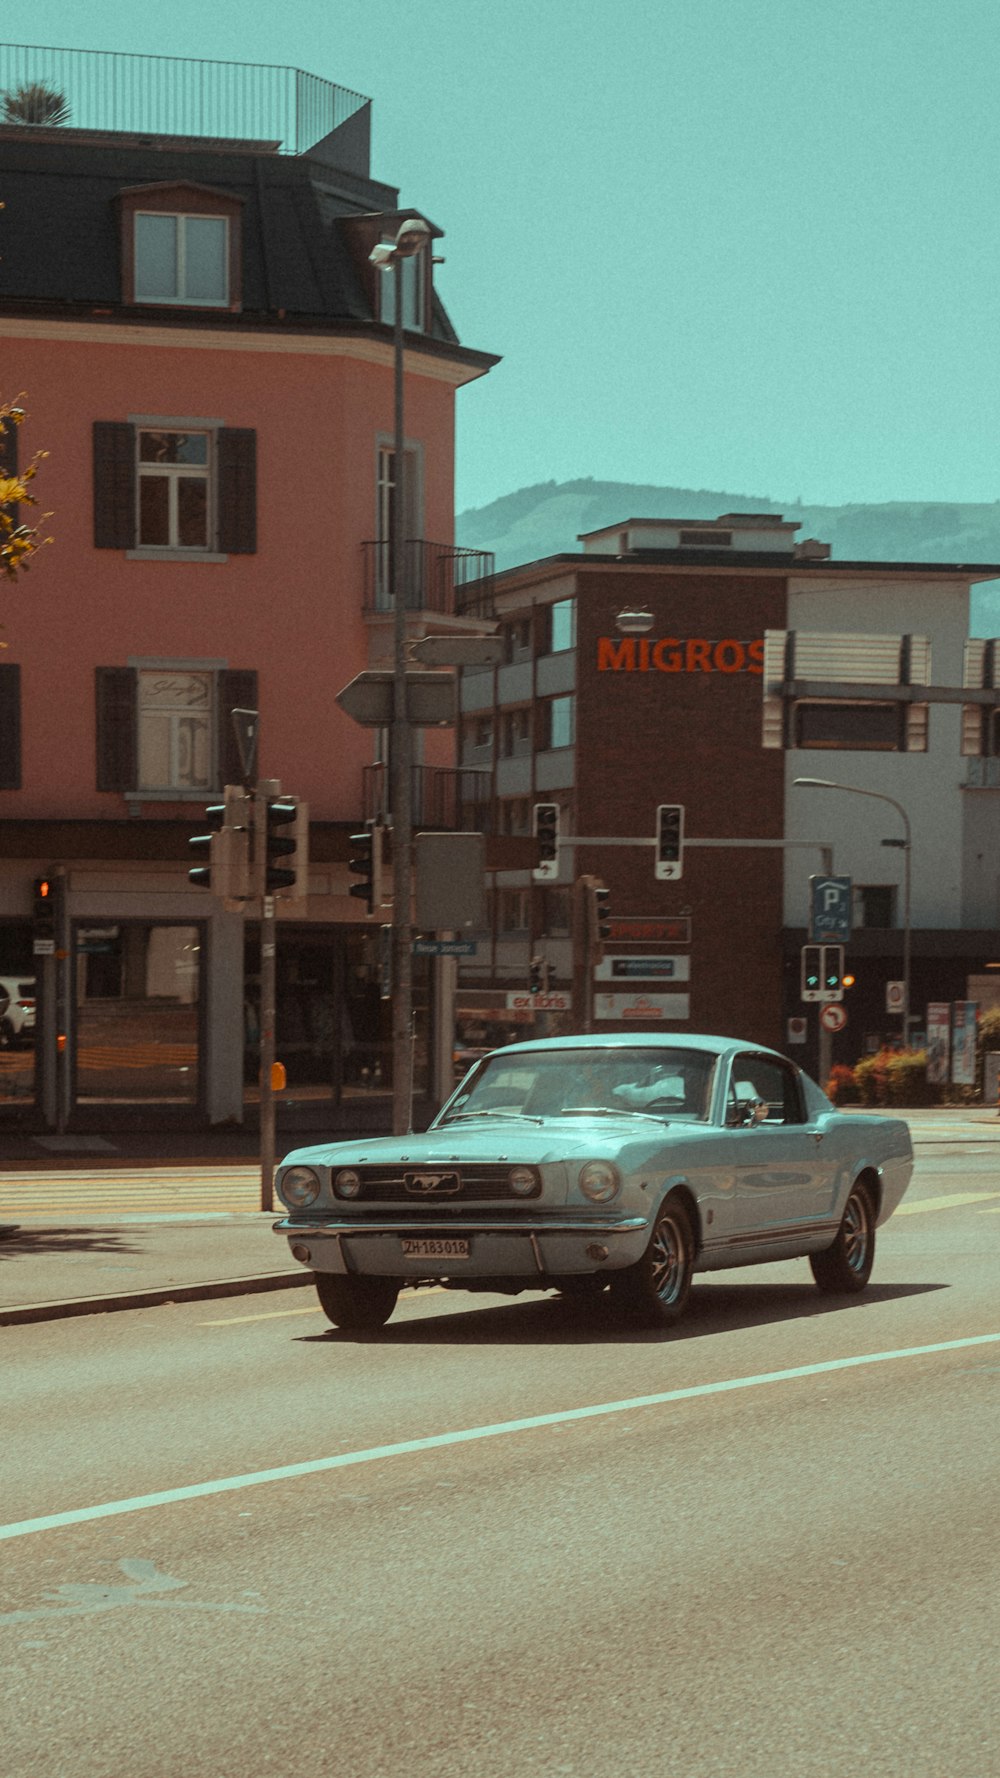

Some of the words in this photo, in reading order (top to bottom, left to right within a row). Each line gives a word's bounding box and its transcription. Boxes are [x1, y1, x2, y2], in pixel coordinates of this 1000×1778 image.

[597, 636, 765, 674] MIGROS
[823, 888, 840, 912] P
[513, 996, 530, 1008] ex
